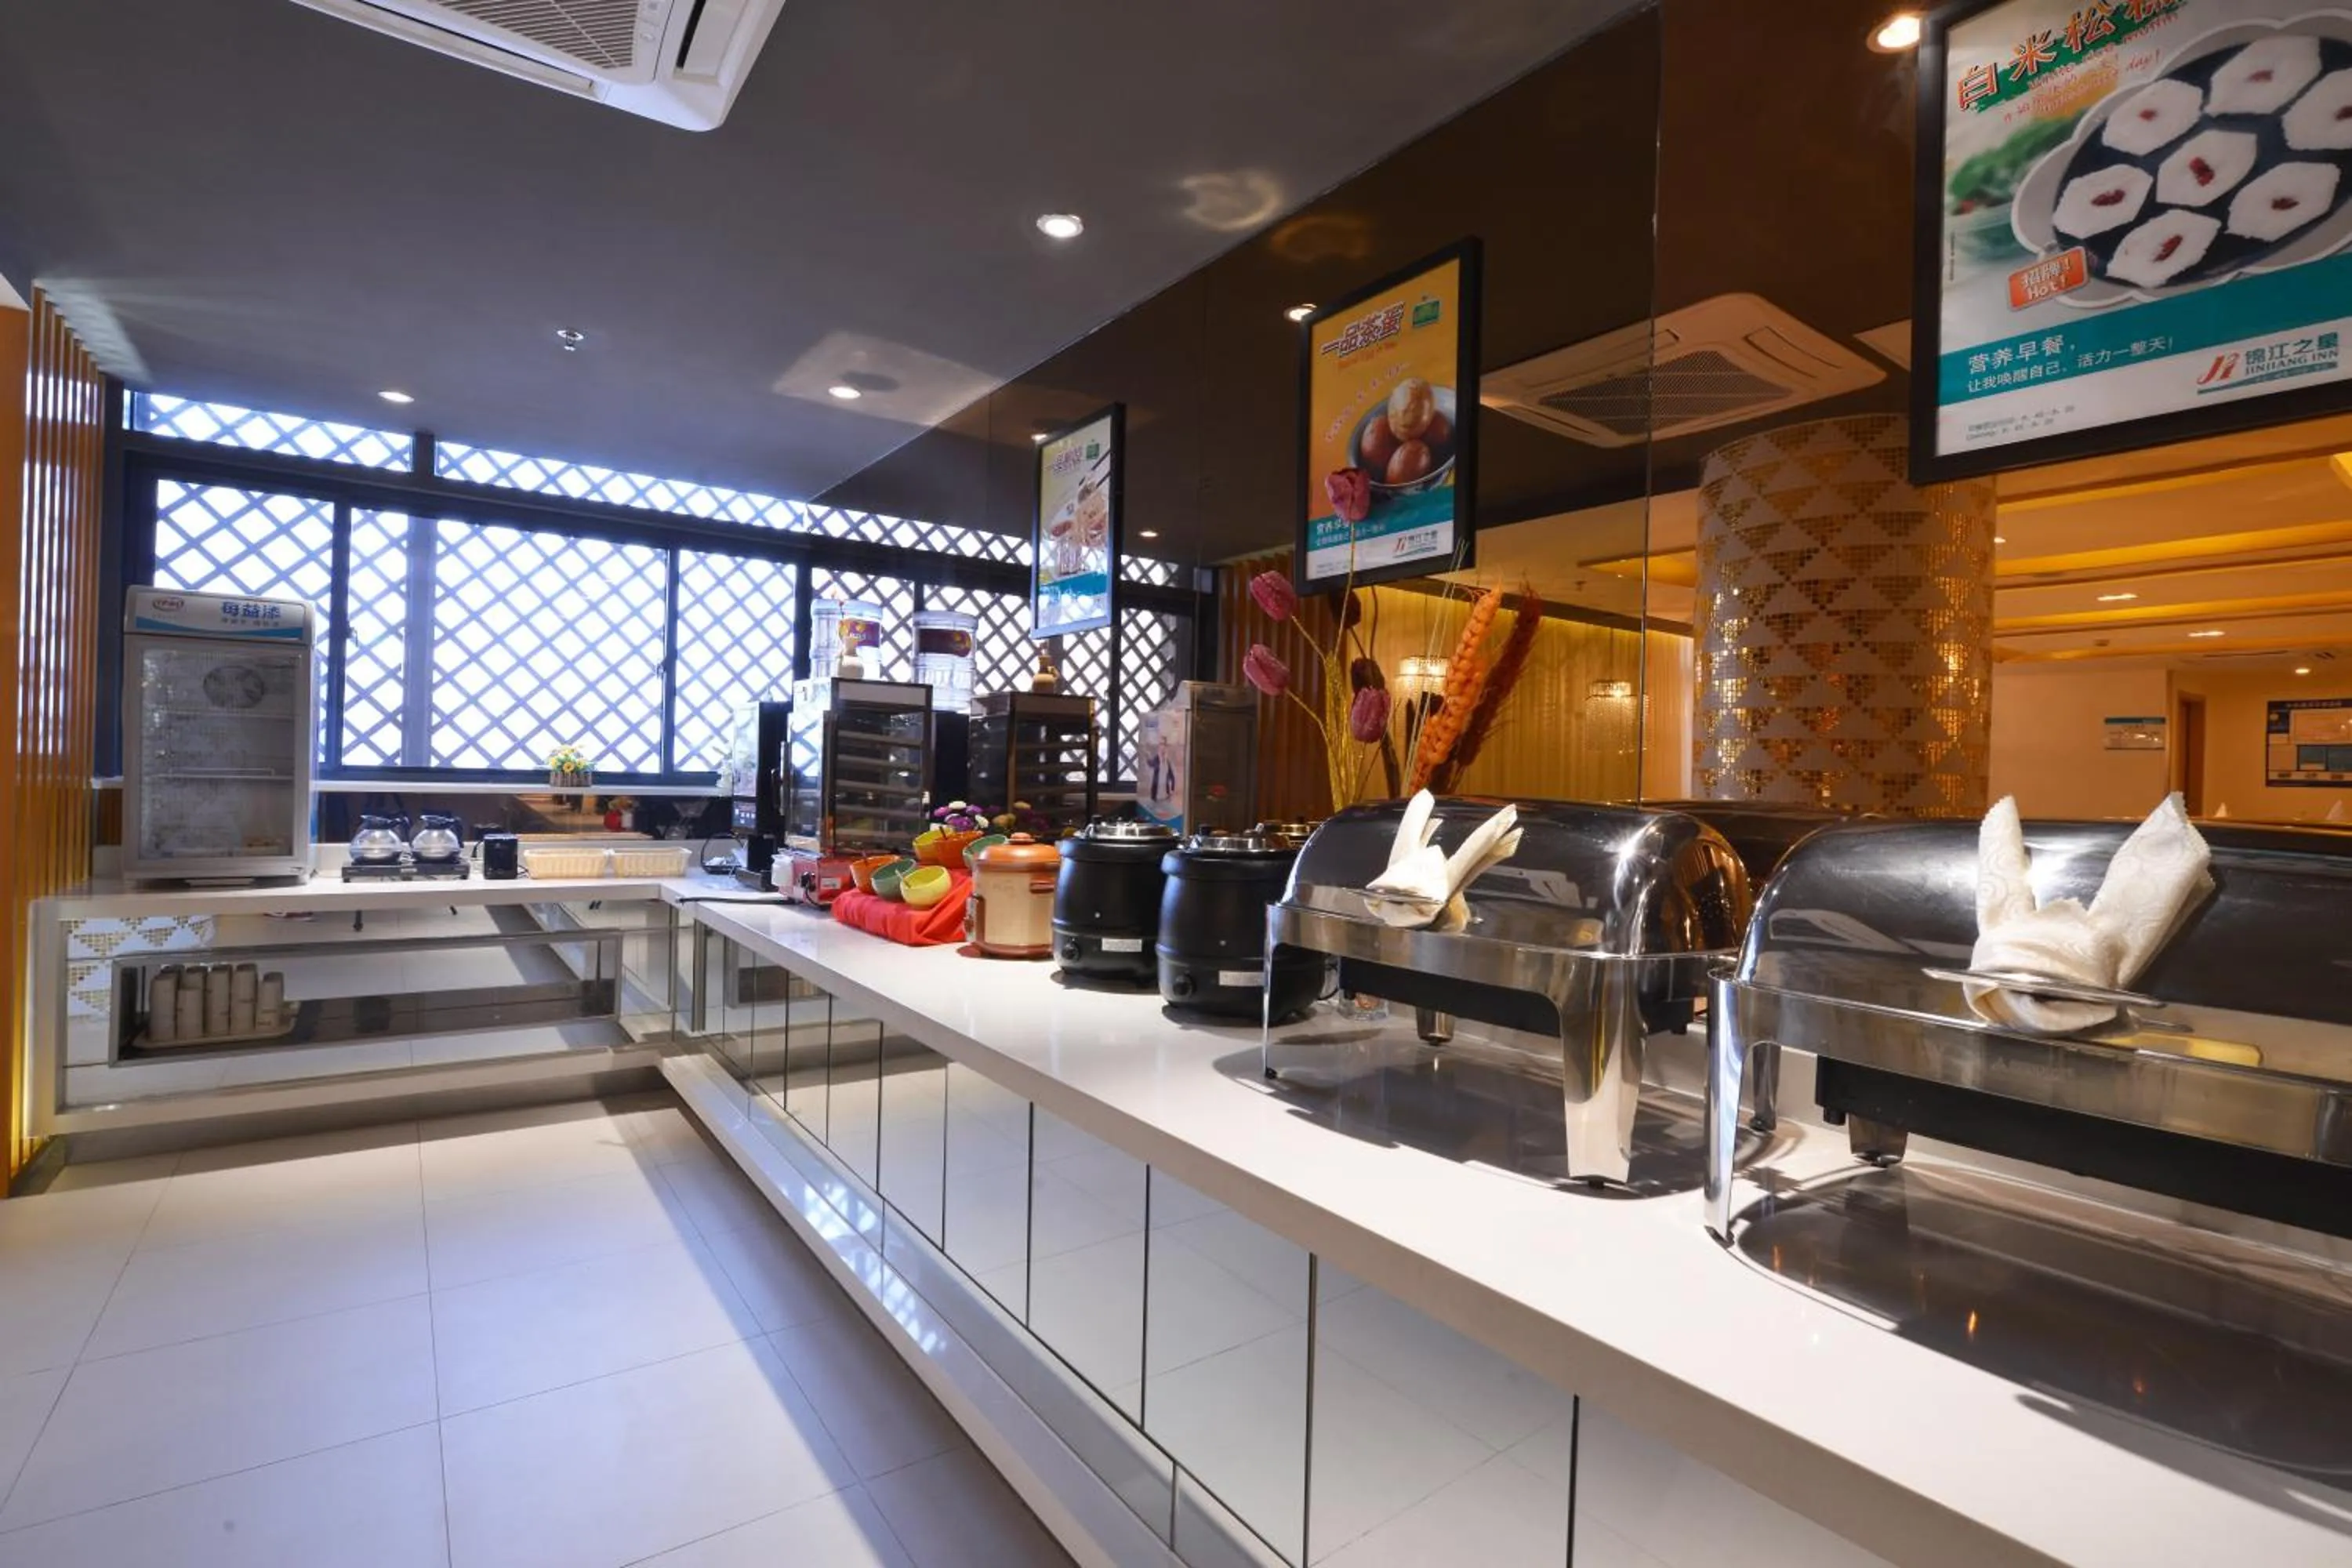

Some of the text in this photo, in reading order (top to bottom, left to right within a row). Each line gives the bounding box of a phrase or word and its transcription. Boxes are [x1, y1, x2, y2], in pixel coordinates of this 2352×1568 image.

[2245, 332, 2338, 365] 锦江之星
[2312, 350, 2339, 362] INN
